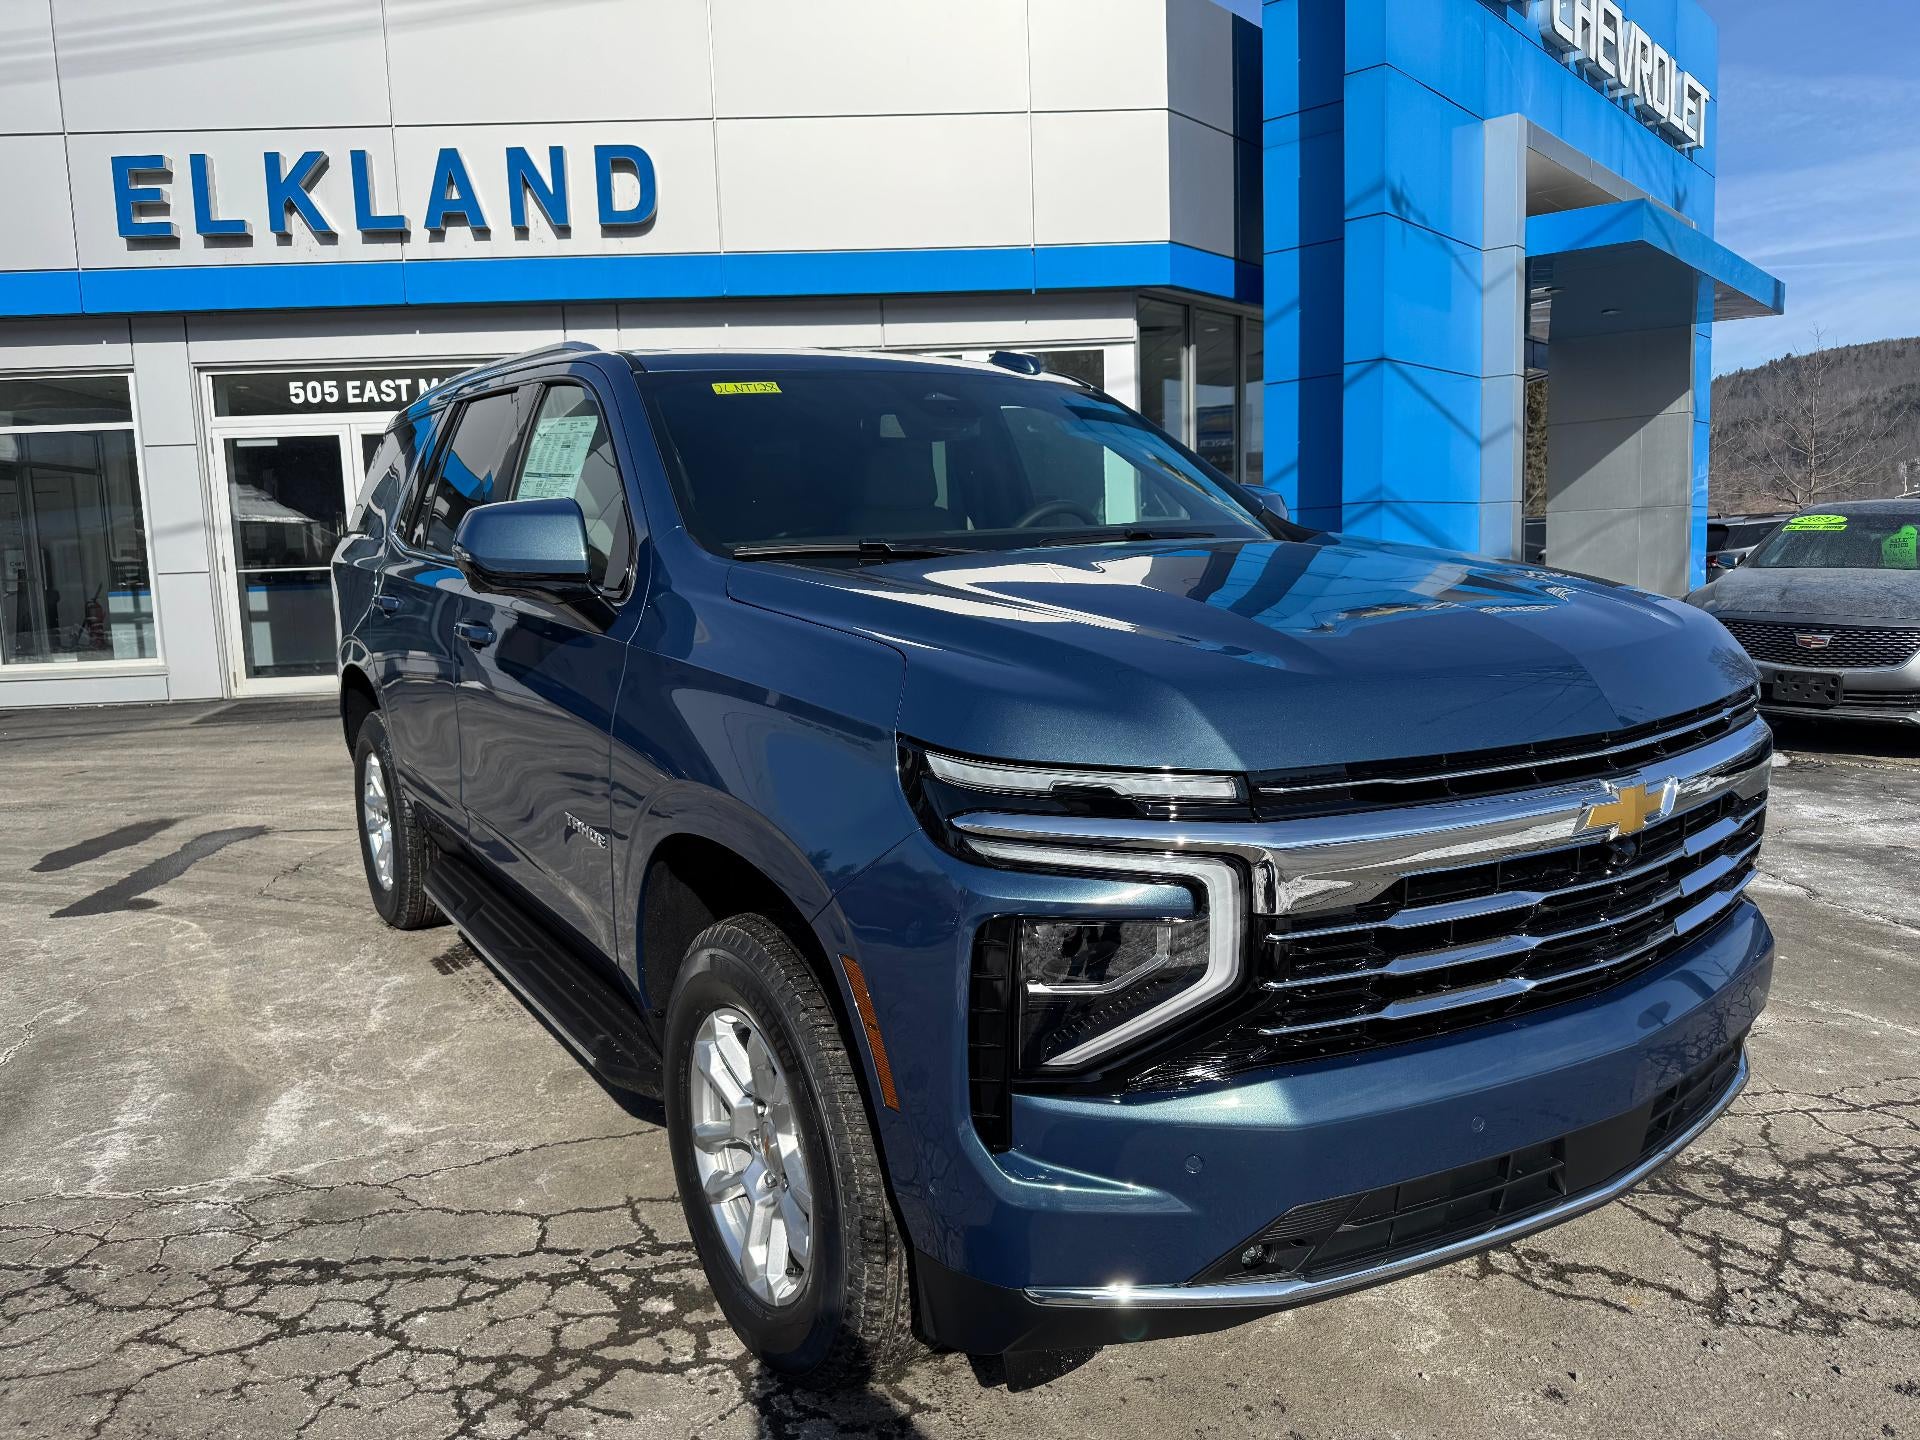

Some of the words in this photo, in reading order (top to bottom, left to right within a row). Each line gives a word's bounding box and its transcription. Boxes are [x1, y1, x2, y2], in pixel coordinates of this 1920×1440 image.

[1546, 0, 1710, 149] CHEVROLET
[111, 144, 659, 240] ELKLAND
[289, 380, 339, 404] 505
[346, 378, 412, 404] EAST
